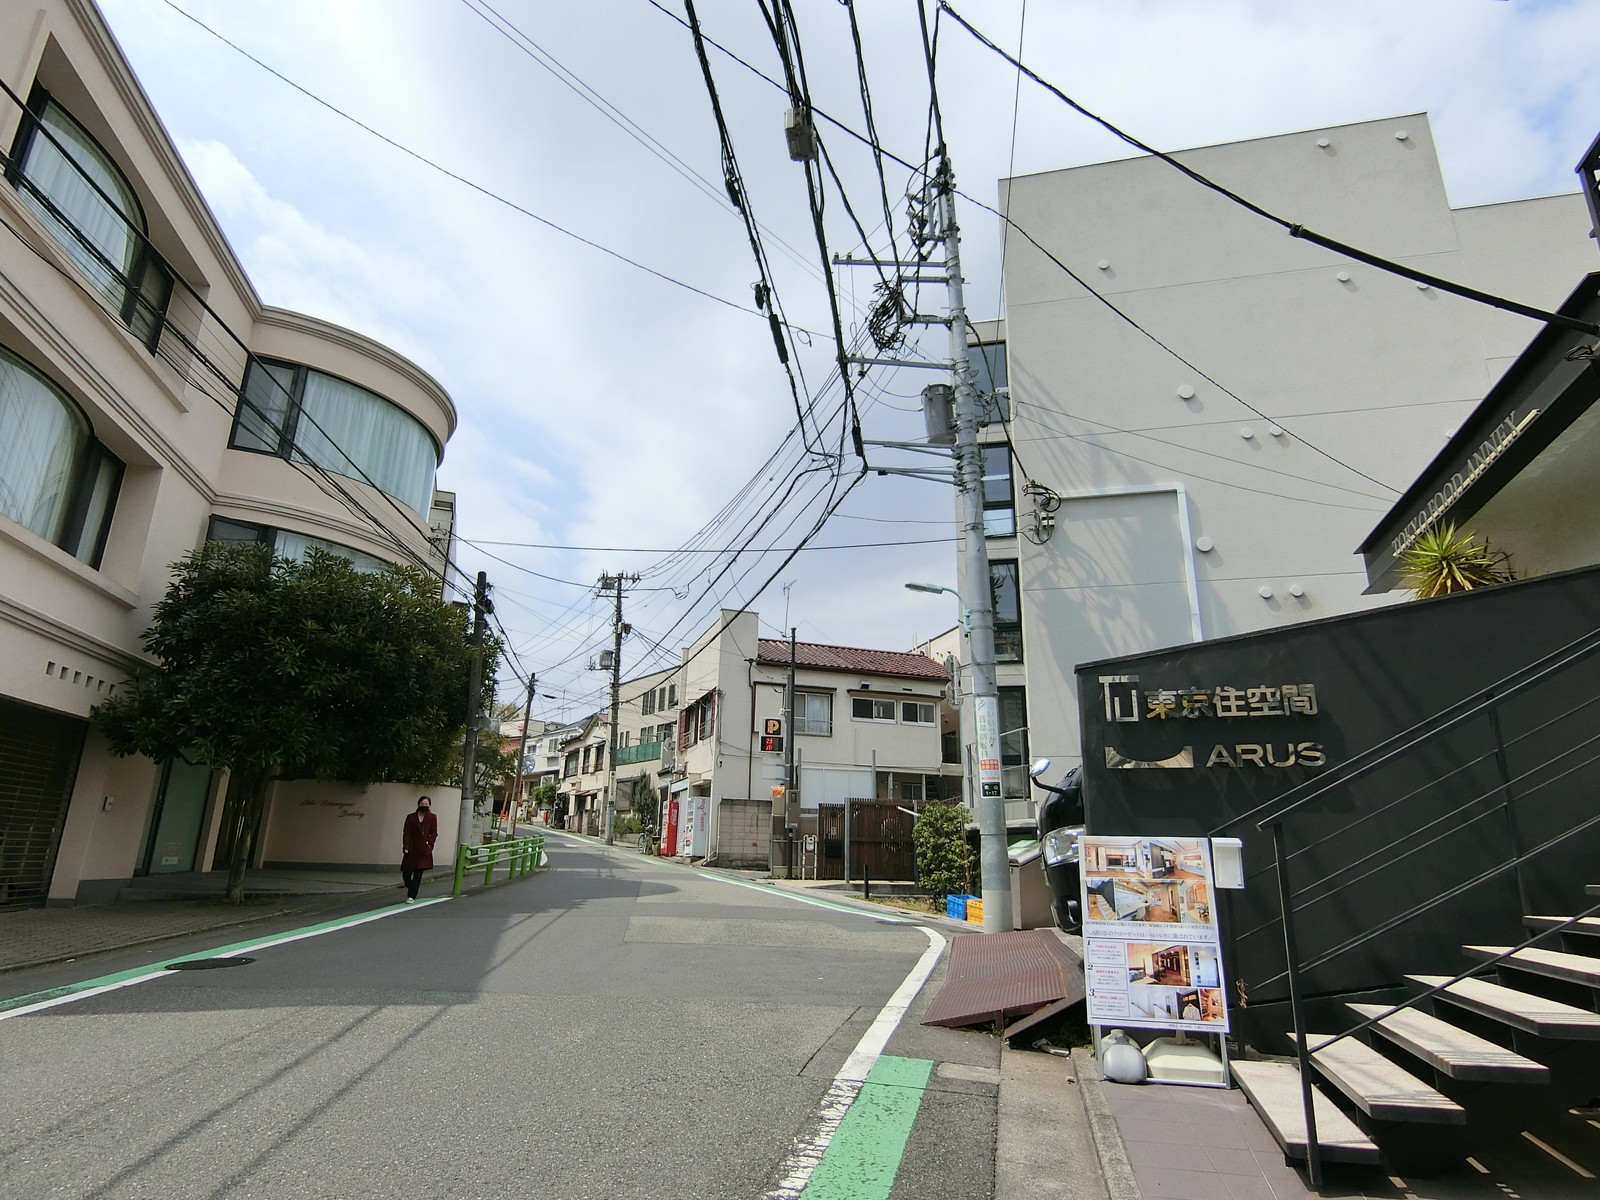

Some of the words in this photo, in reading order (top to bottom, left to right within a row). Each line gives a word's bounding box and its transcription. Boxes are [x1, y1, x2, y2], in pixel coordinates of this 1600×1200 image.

[1392, 510, 1427, 553] TOKYO
[1427, 473, 1464, 516] FOOD
[1466, 410, 1518, 480] ANNEX
[1144, 683, 1319, 720] 東京住空間
[1205, 741, 1327, 768] ARUS
